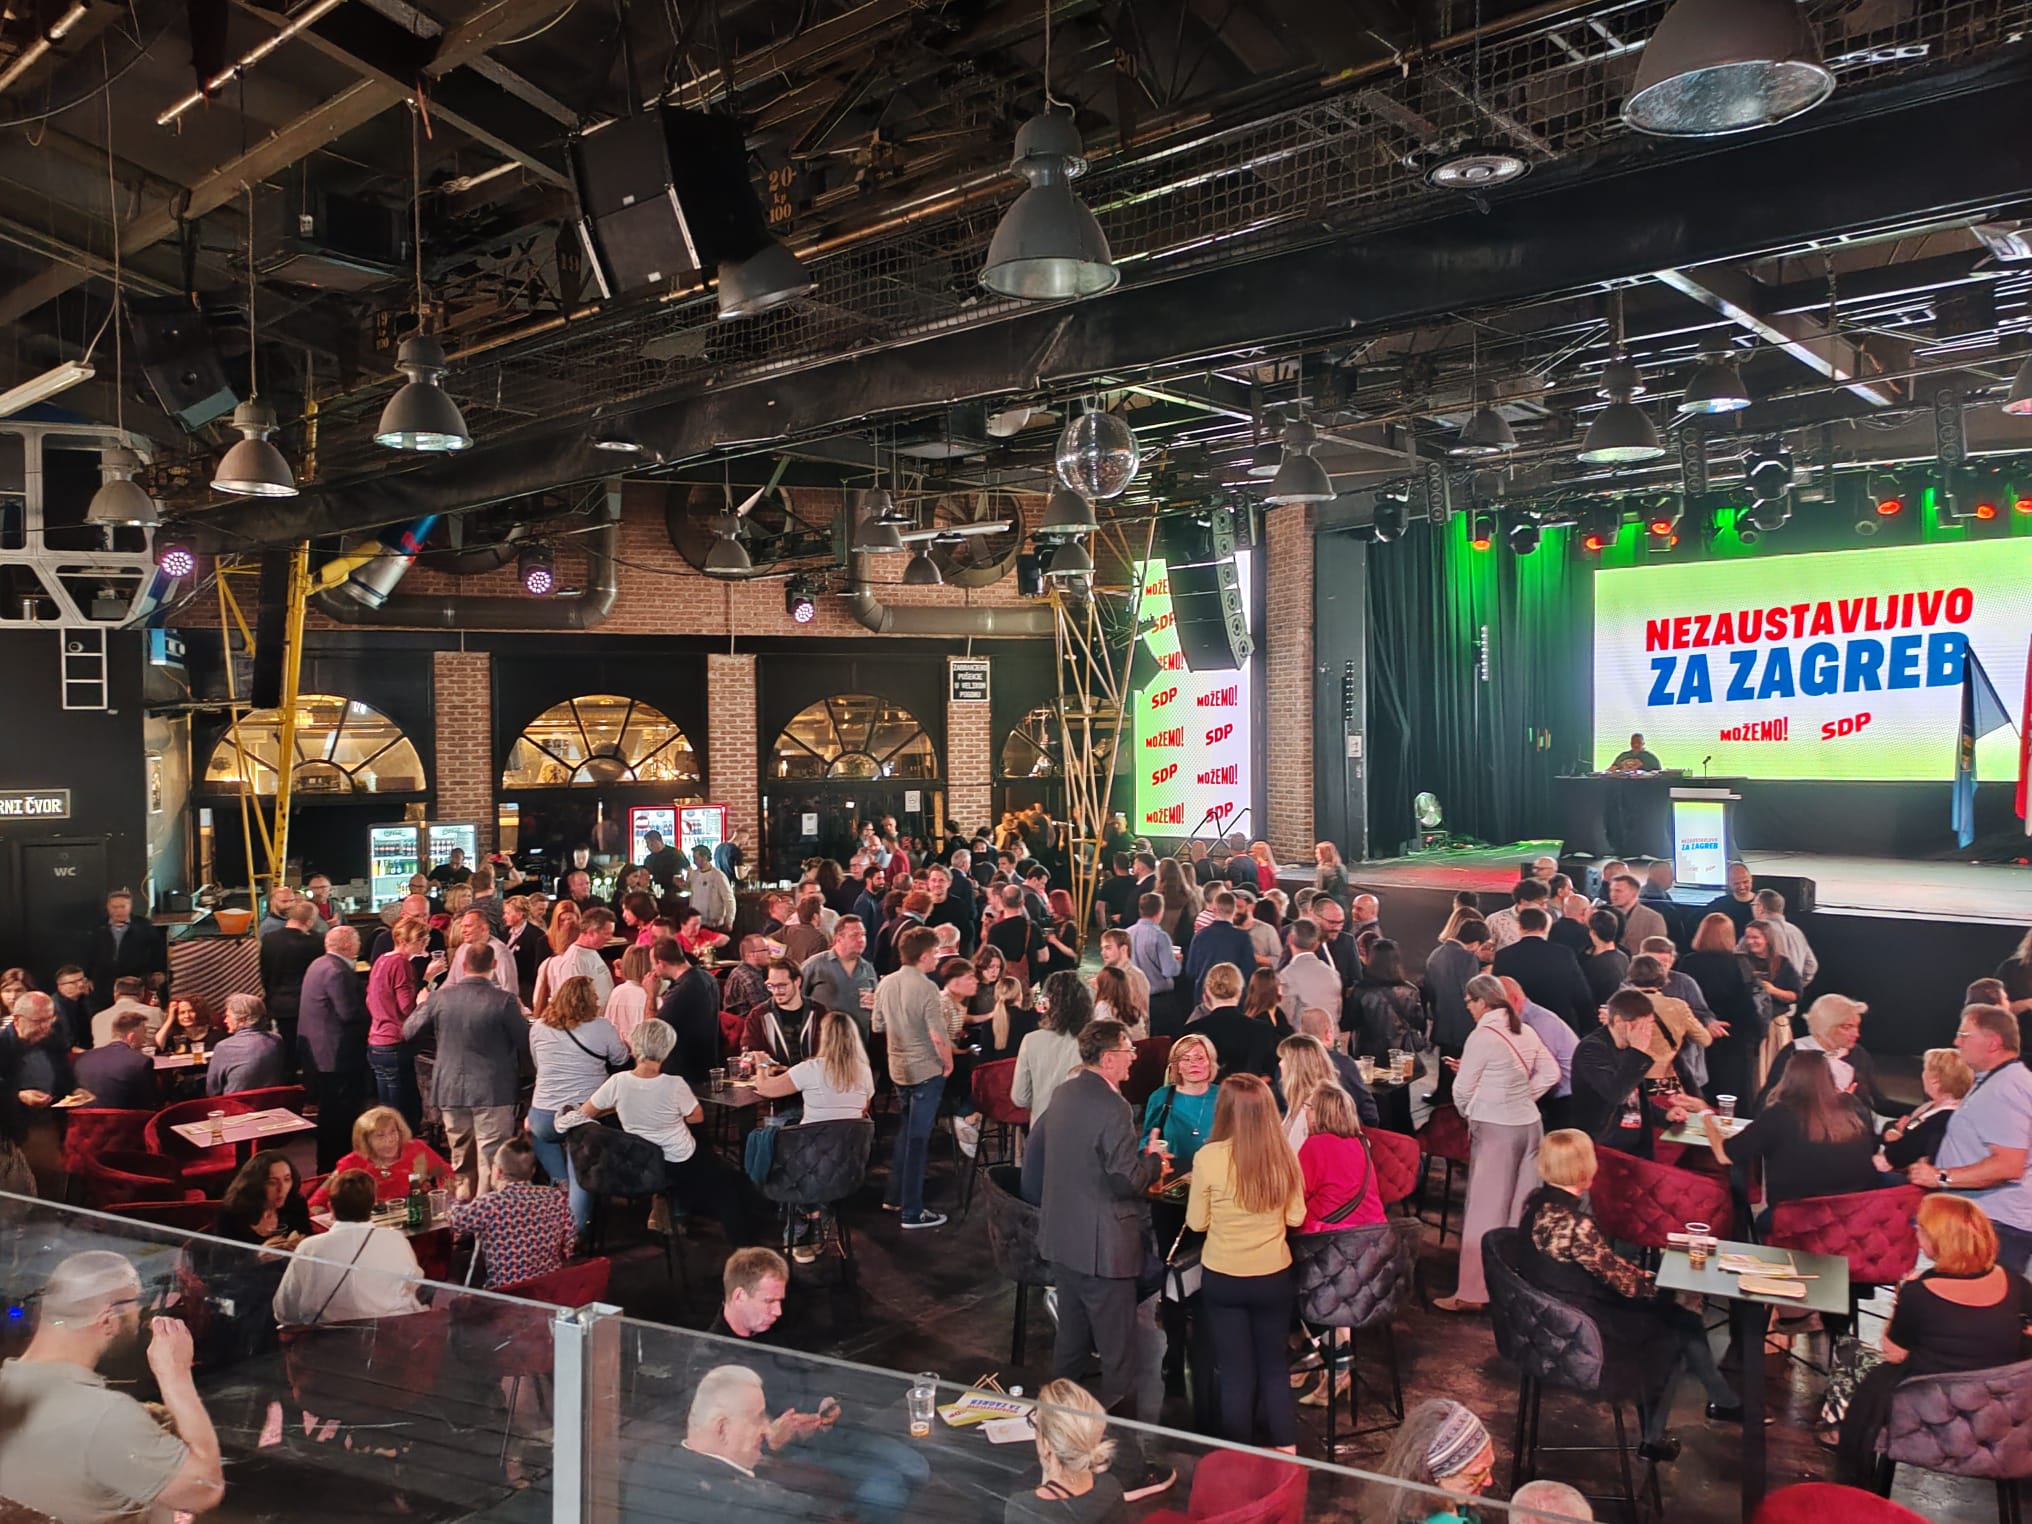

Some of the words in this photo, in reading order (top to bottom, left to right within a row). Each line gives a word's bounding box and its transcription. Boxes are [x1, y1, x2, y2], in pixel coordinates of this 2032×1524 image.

[770, 203, 792, 223] 100
[1645, 587, 1974, 652] NEZAUSTAVLJIVO
[1647, 653, 1713, 707] ZA
[1725, 631, 1970, 701] ZAGREB
[1151, 687, 1178, 710] SDP
[1196, 684, 1238, 707] MOŽEMO!
[1145, 725, 1184, 748] MOŽEMO!
[1205, 723, 1233, 746] SDP
[1720, 717, 1788, 741] MOŽEMO!
[1821, 712, 1871, 741] SDP
[1151, 763, 1178, 786] SDP
[1196, 763, 1238, 785] MOŽEMO!
[24, 796, 63, 814] ČVOR
[1146, 802, 1185, 824] MOŽEMO!
[1206, 801, 1234, 823] SDP
[53, 866, 77, 877] WC
